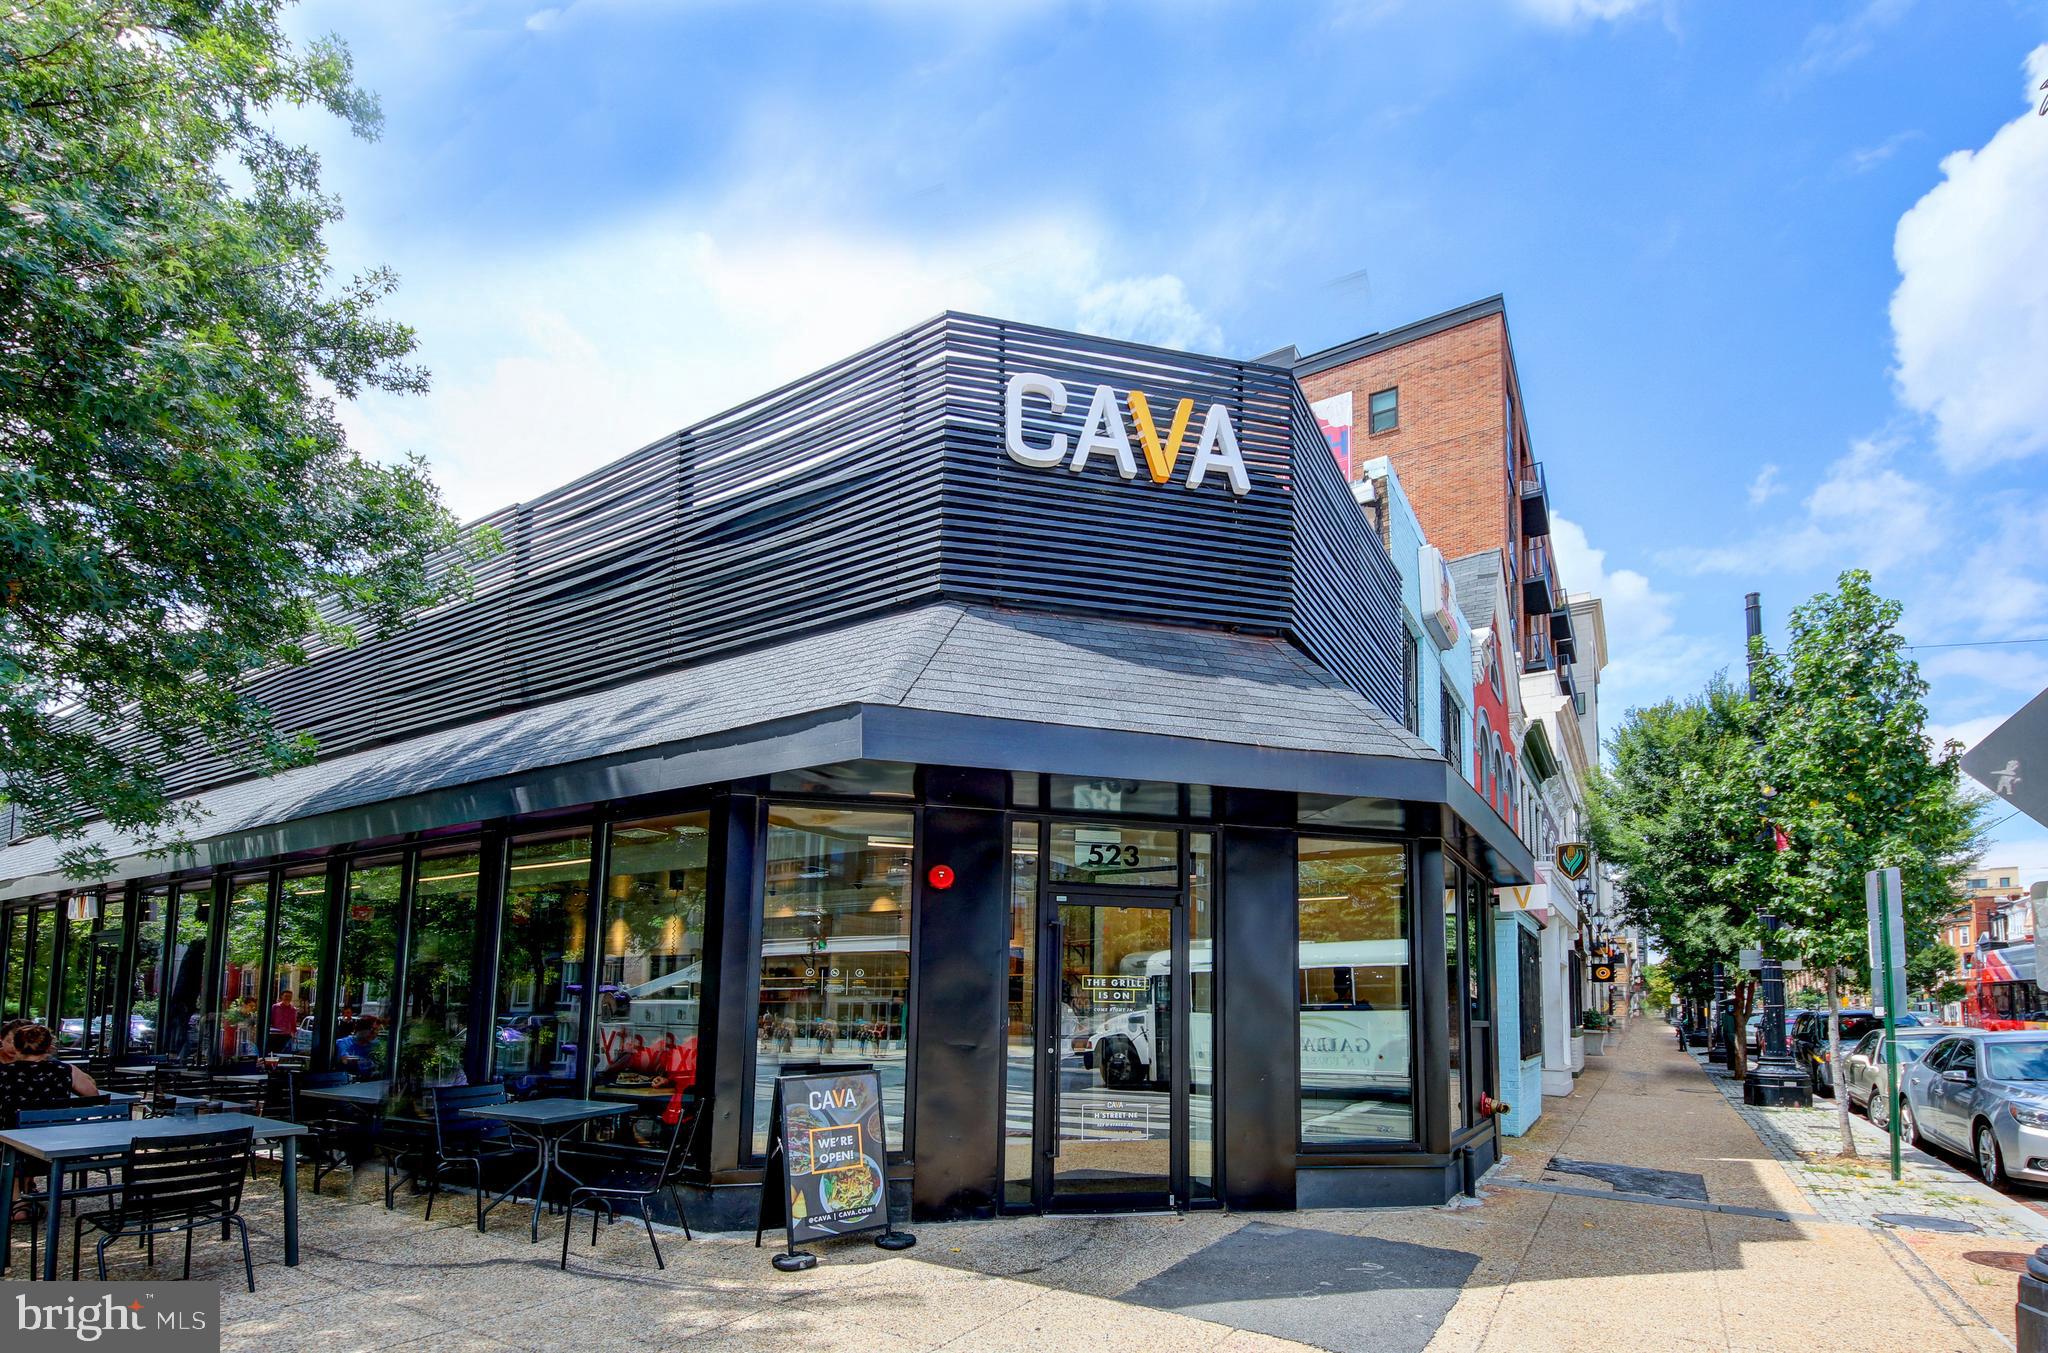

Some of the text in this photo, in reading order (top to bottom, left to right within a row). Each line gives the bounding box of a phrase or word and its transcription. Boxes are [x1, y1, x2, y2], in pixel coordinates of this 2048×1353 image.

[1005, 372, 1252, 496] CAVA
[1088, 844, 1140, 867] 523
[1086, 978, 1143, 987] THE GRILL
[1098, 991, 1130, 1000] IS ON
[809, 1088, 857, 1111] CAVA
[1107, 1101, 1124, 1109] CAVA
[818, 1135, 854, 1149] WE'RE
[819, 1150, 854, 1164] OPEN!
[808, 1206, 873, 1224] @CAVA CAVA.COM
